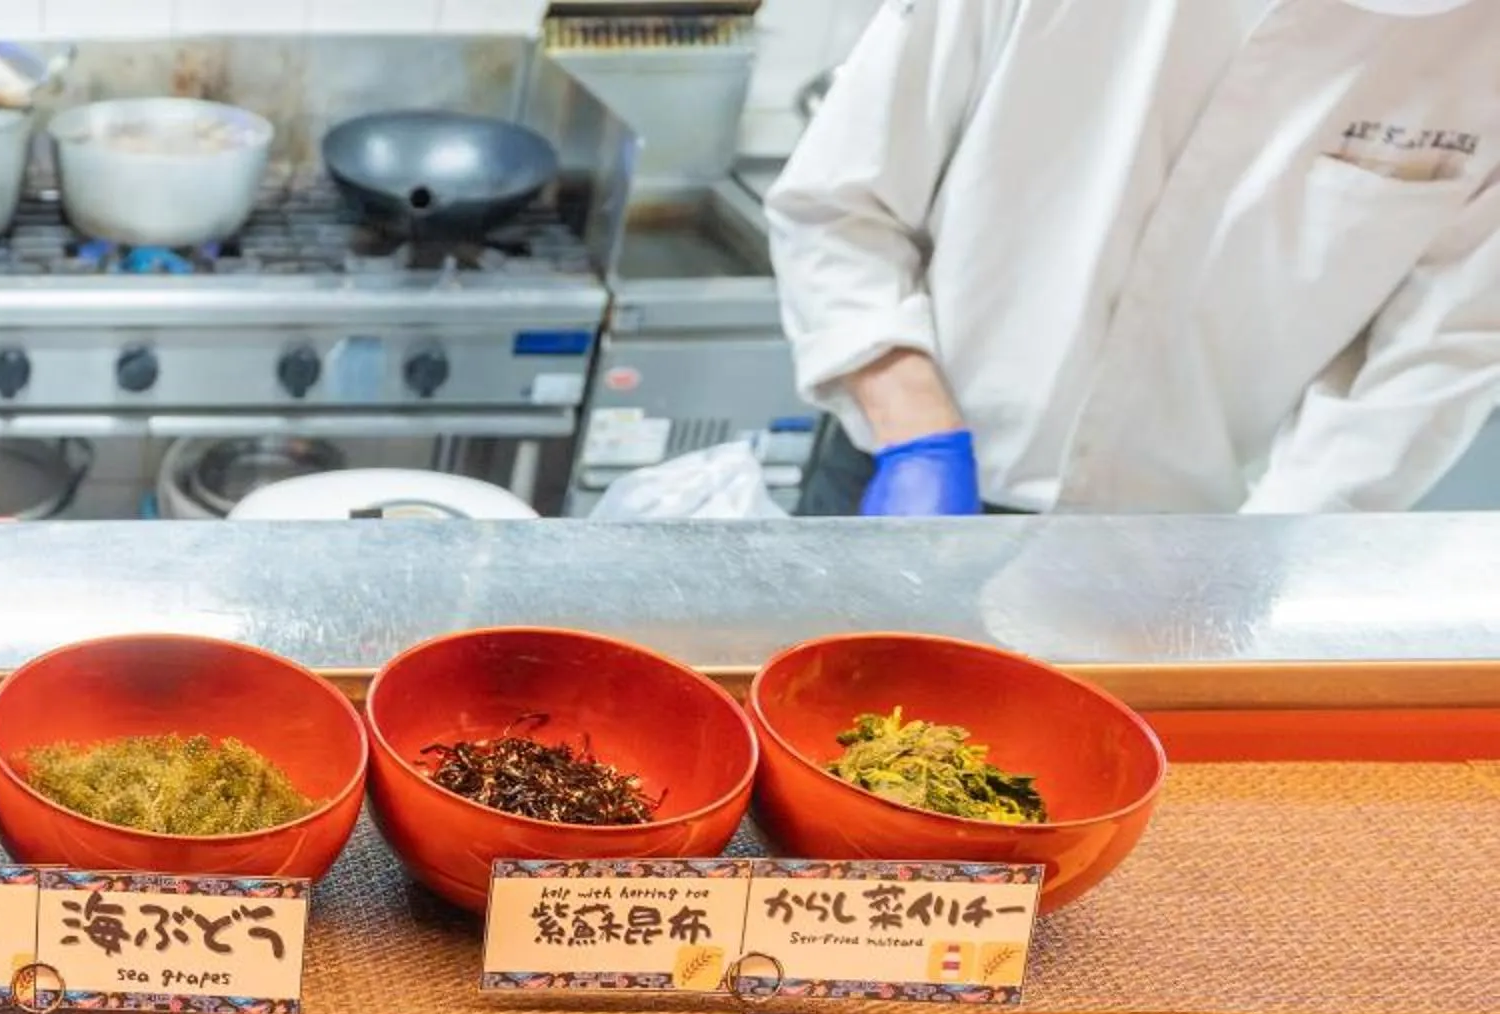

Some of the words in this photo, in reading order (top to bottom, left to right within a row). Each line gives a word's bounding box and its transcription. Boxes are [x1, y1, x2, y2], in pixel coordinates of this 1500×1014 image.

[578, 886, 612, 899] with
[620, 886, 678, 900] herring
[764, 884, 1026, 930] からし菜イリチー
[60, 891, 284, 959] 海ぶどう
[531, 902, 712, 945] 紫蘇昆布
[117, 968, 149, 983] sea
[162, 969, 232, 988] grapes
